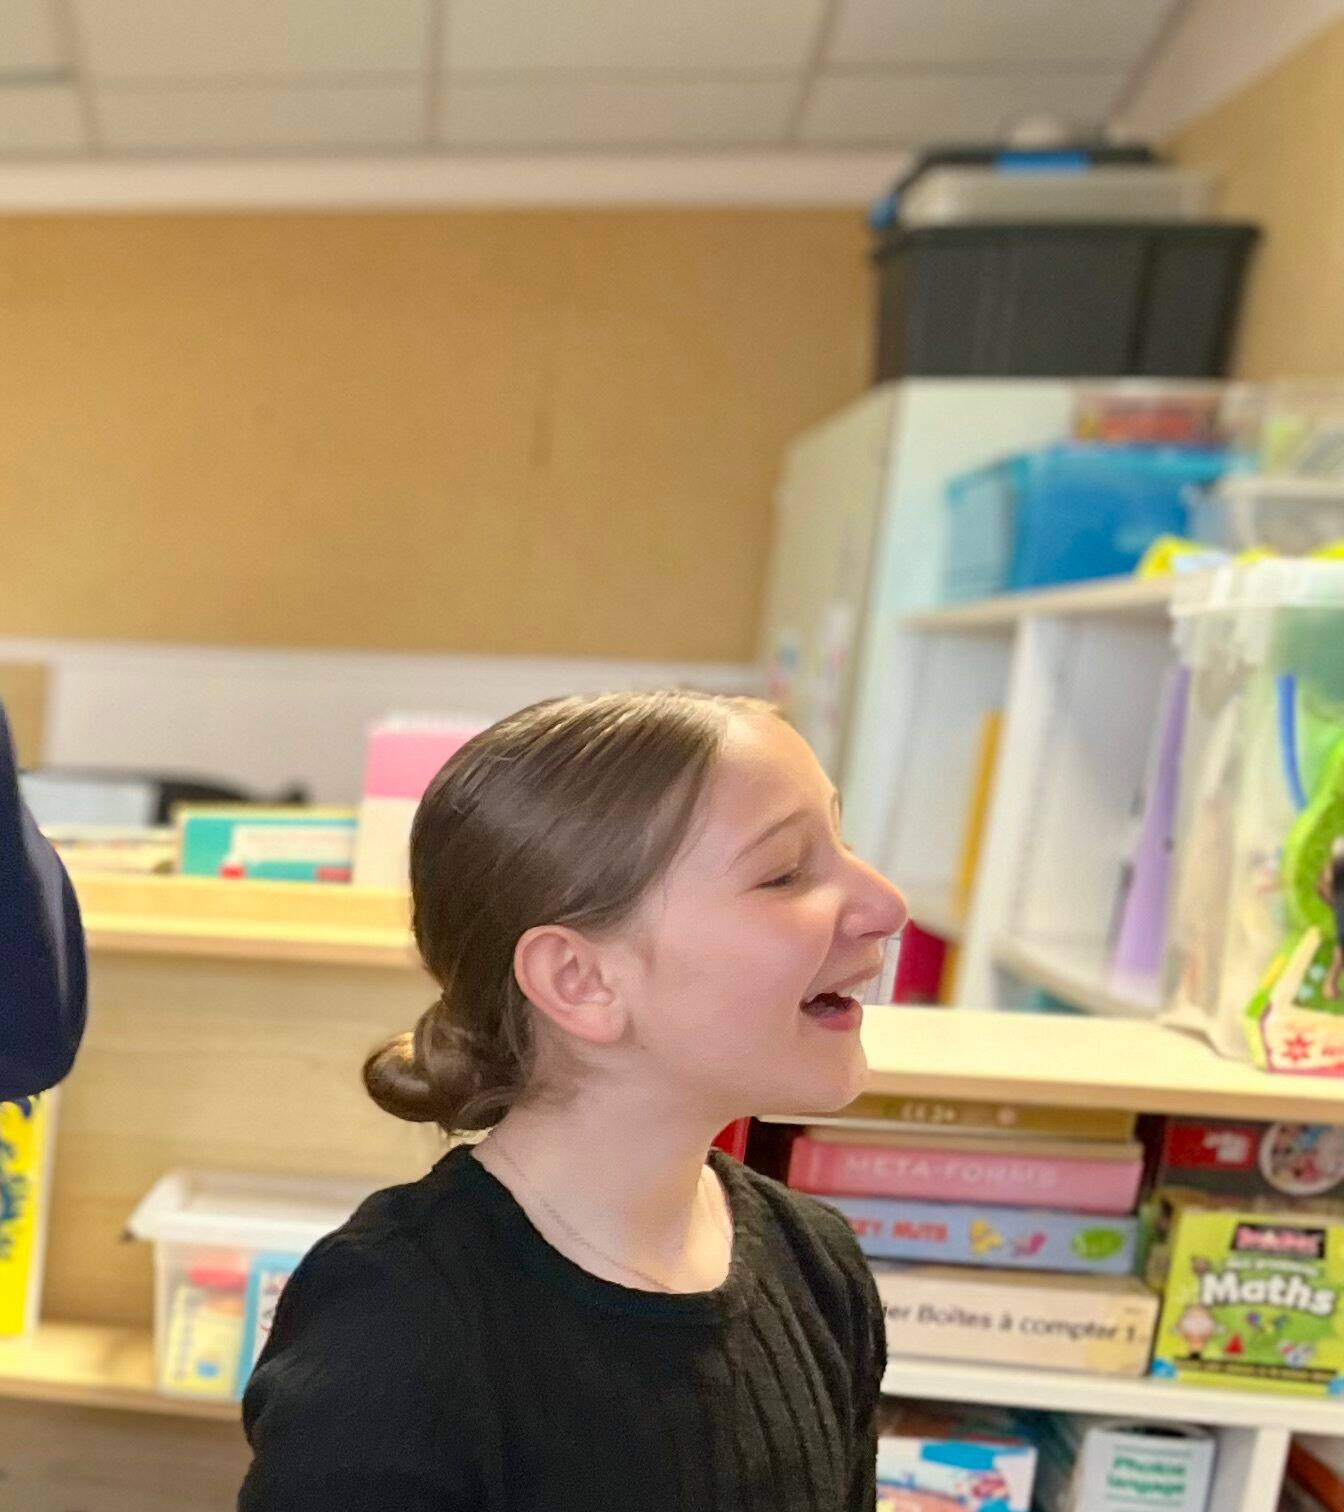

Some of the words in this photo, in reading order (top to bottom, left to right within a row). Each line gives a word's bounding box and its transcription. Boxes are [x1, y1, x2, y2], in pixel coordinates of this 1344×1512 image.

[1202, 1268, 1336, 1316] Maths
[998, 1312, 1013, 1332] à
[1018, 1316, 1117, 1342] compter
